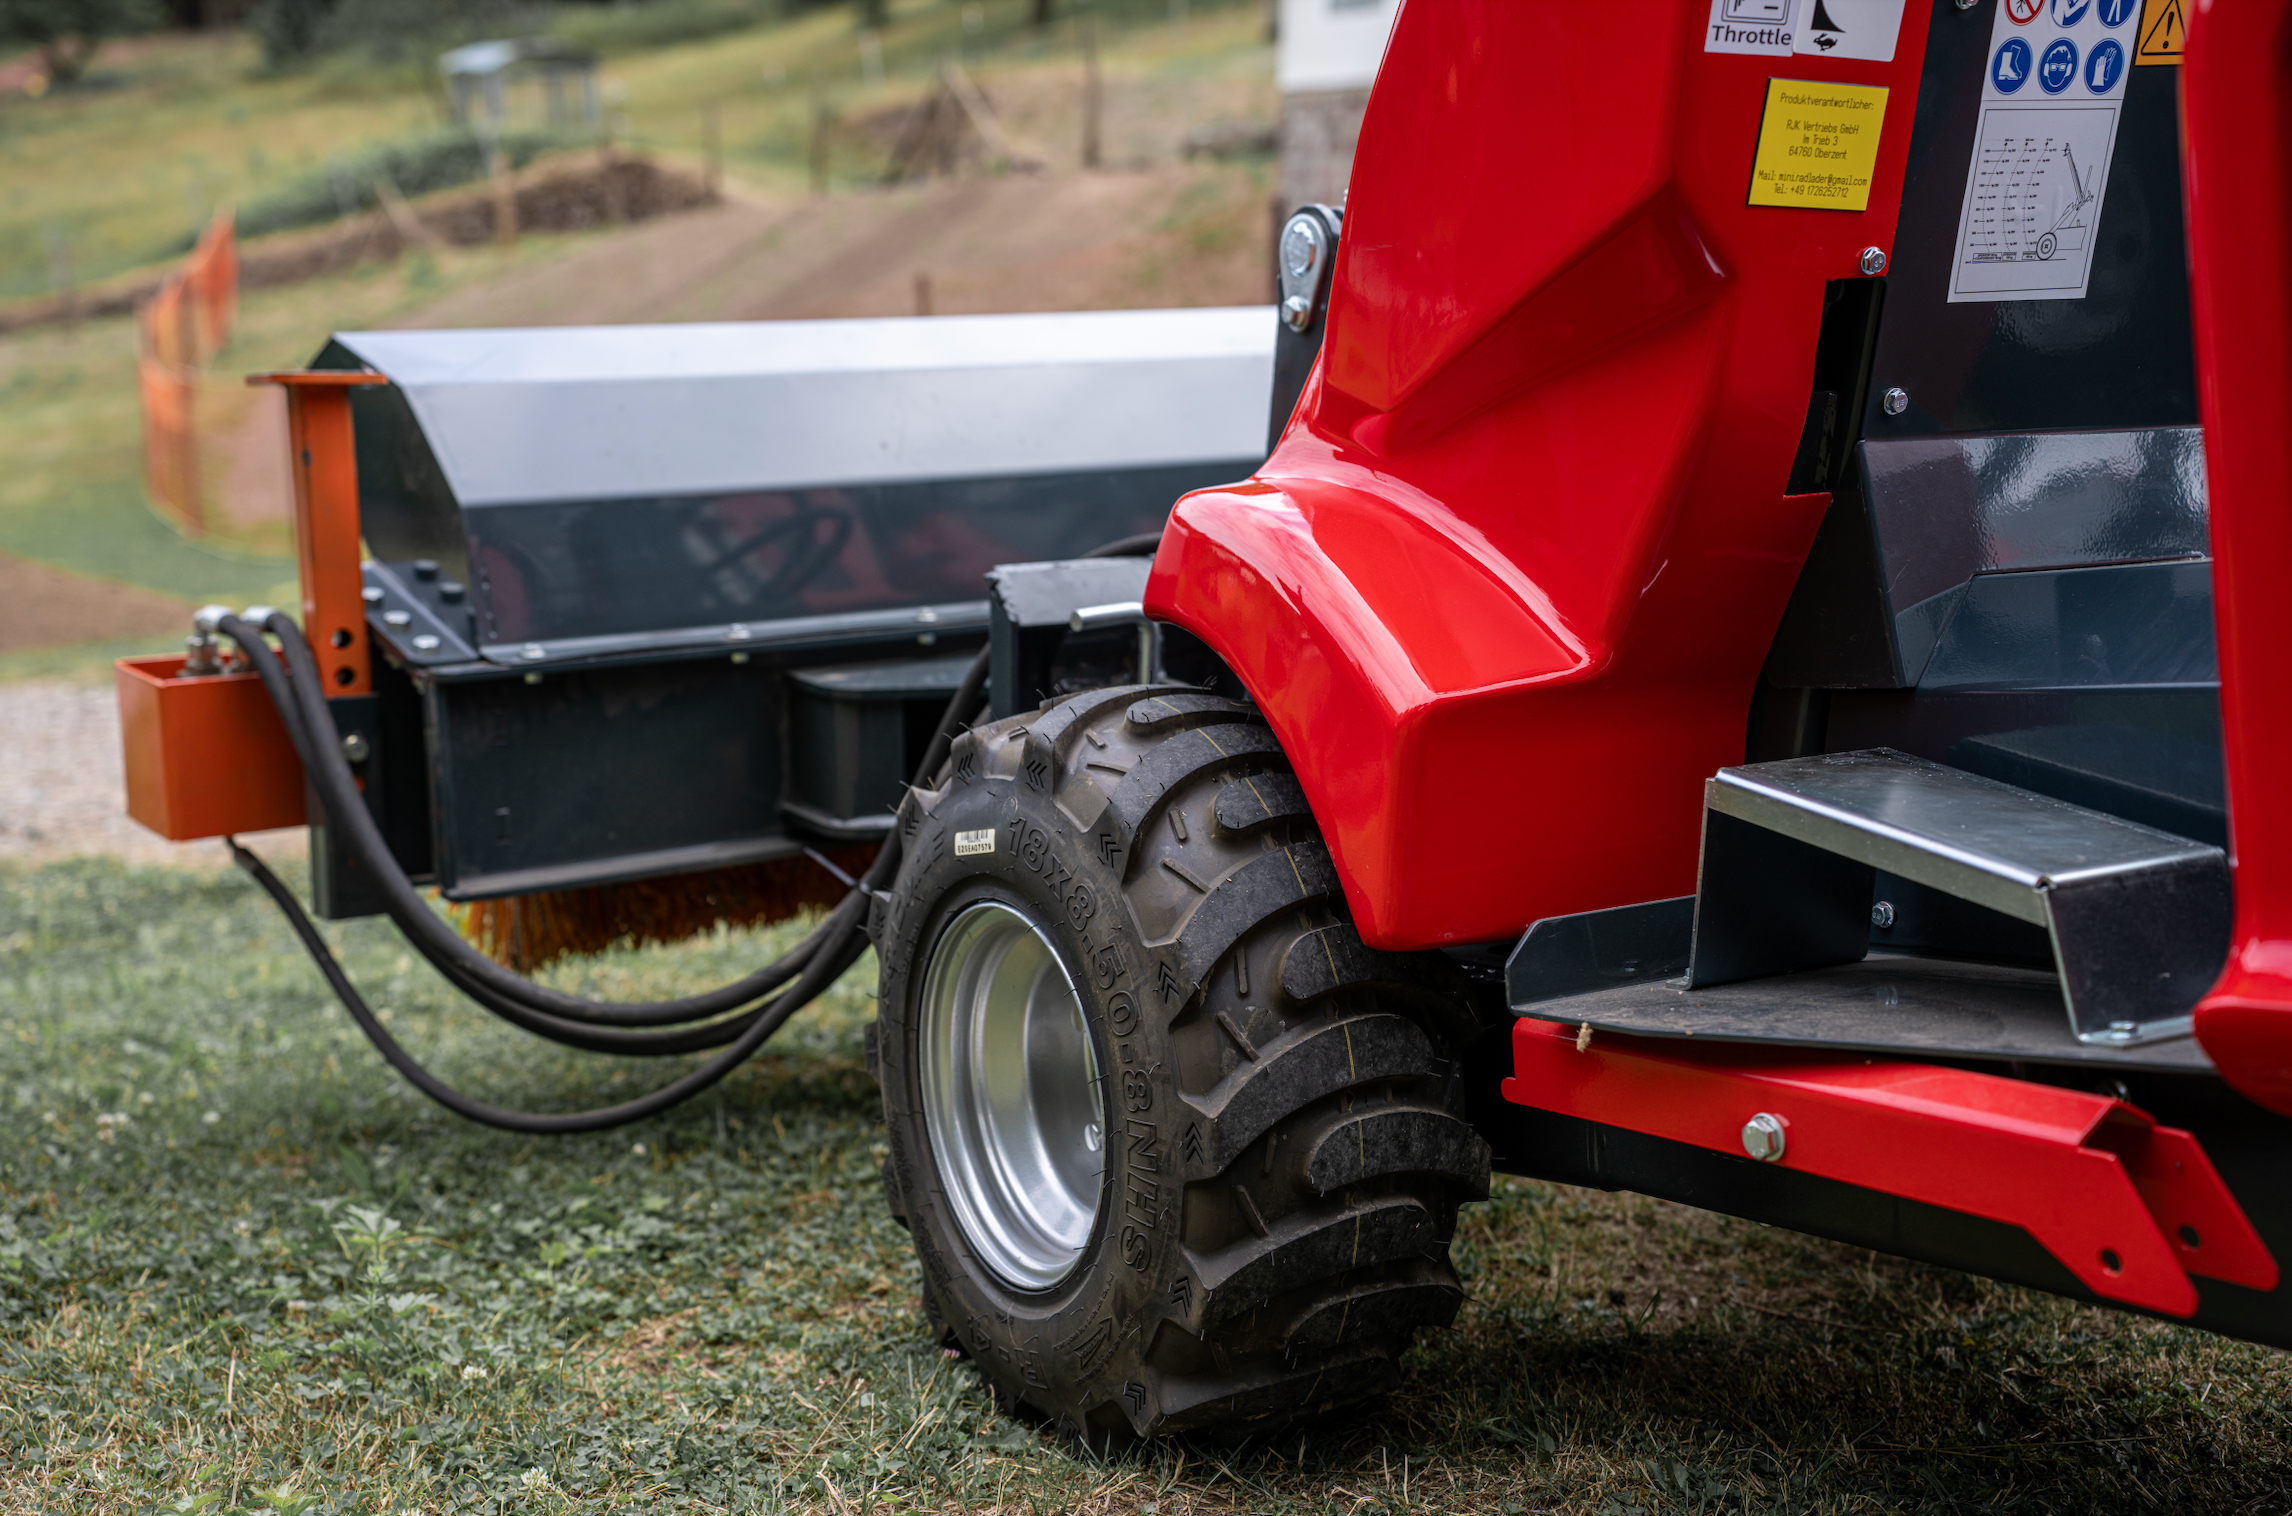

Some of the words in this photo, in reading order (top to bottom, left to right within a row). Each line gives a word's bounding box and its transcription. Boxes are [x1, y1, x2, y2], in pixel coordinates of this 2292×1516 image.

[1712, 25, 1792, 46] Throttle
[1779, 92, 1875, 110] Produktverantwortlicher:
[1786, 119, 1801, 131] RJK
[1803, 120, 1838, 134] Vertriebs
[1840, 123, 1860, 135] GmbH
[1813, 134, 1831, 146] Trieb
[1832, 135, 1839, 146] 3
[1788, 145, 1813, 158] 64760
[1814, 147, 1848, 160] Oberzent
[1757, 169, 1777, 181] Mail:
[1790, 184, 1805, 196] +49
